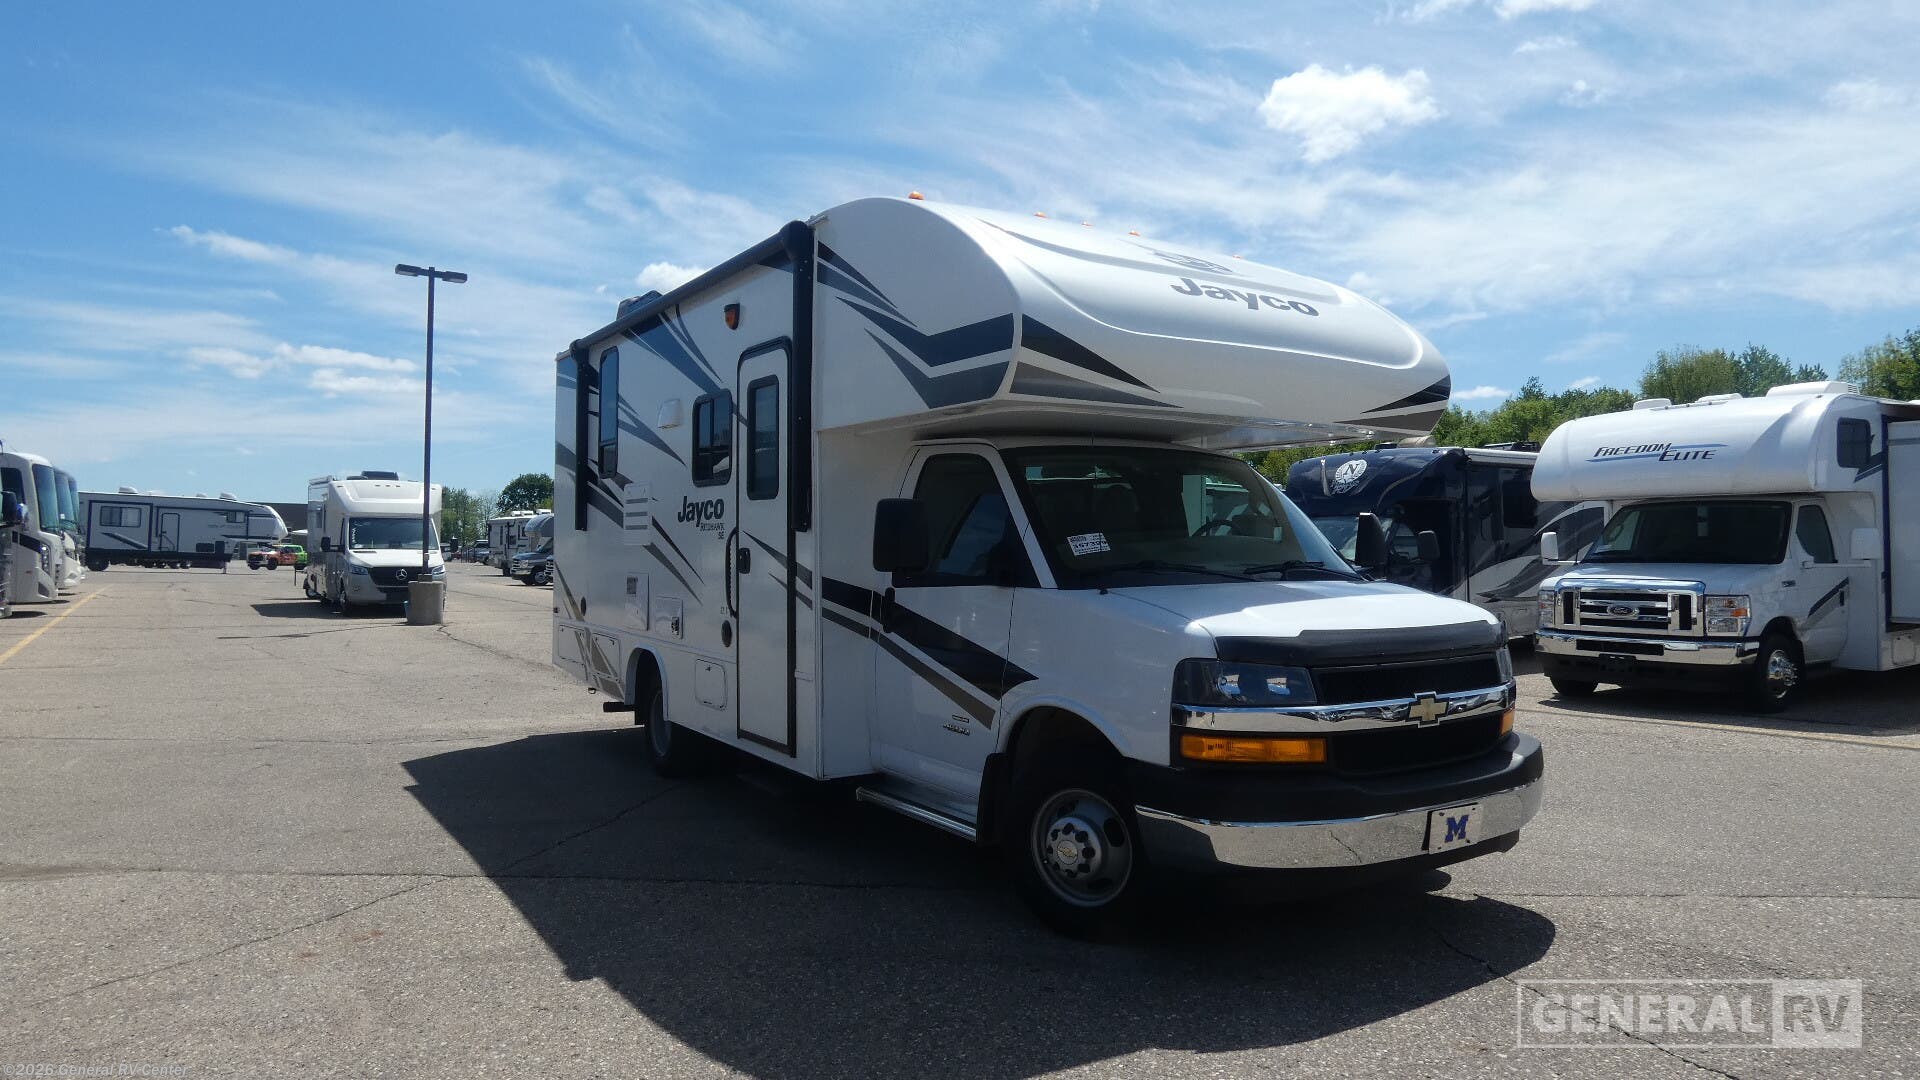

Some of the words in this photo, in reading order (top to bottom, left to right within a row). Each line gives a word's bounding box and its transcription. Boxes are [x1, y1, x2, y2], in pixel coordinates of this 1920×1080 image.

[1170, 278, 1319, 316] Jayco
[1593, 443, 1672, 457] FREEDOM
[1659, 450, 1717, 461] ELITE
[678, 496, 724, 527] Jayco
[1445, 815, 1469, 843] M
